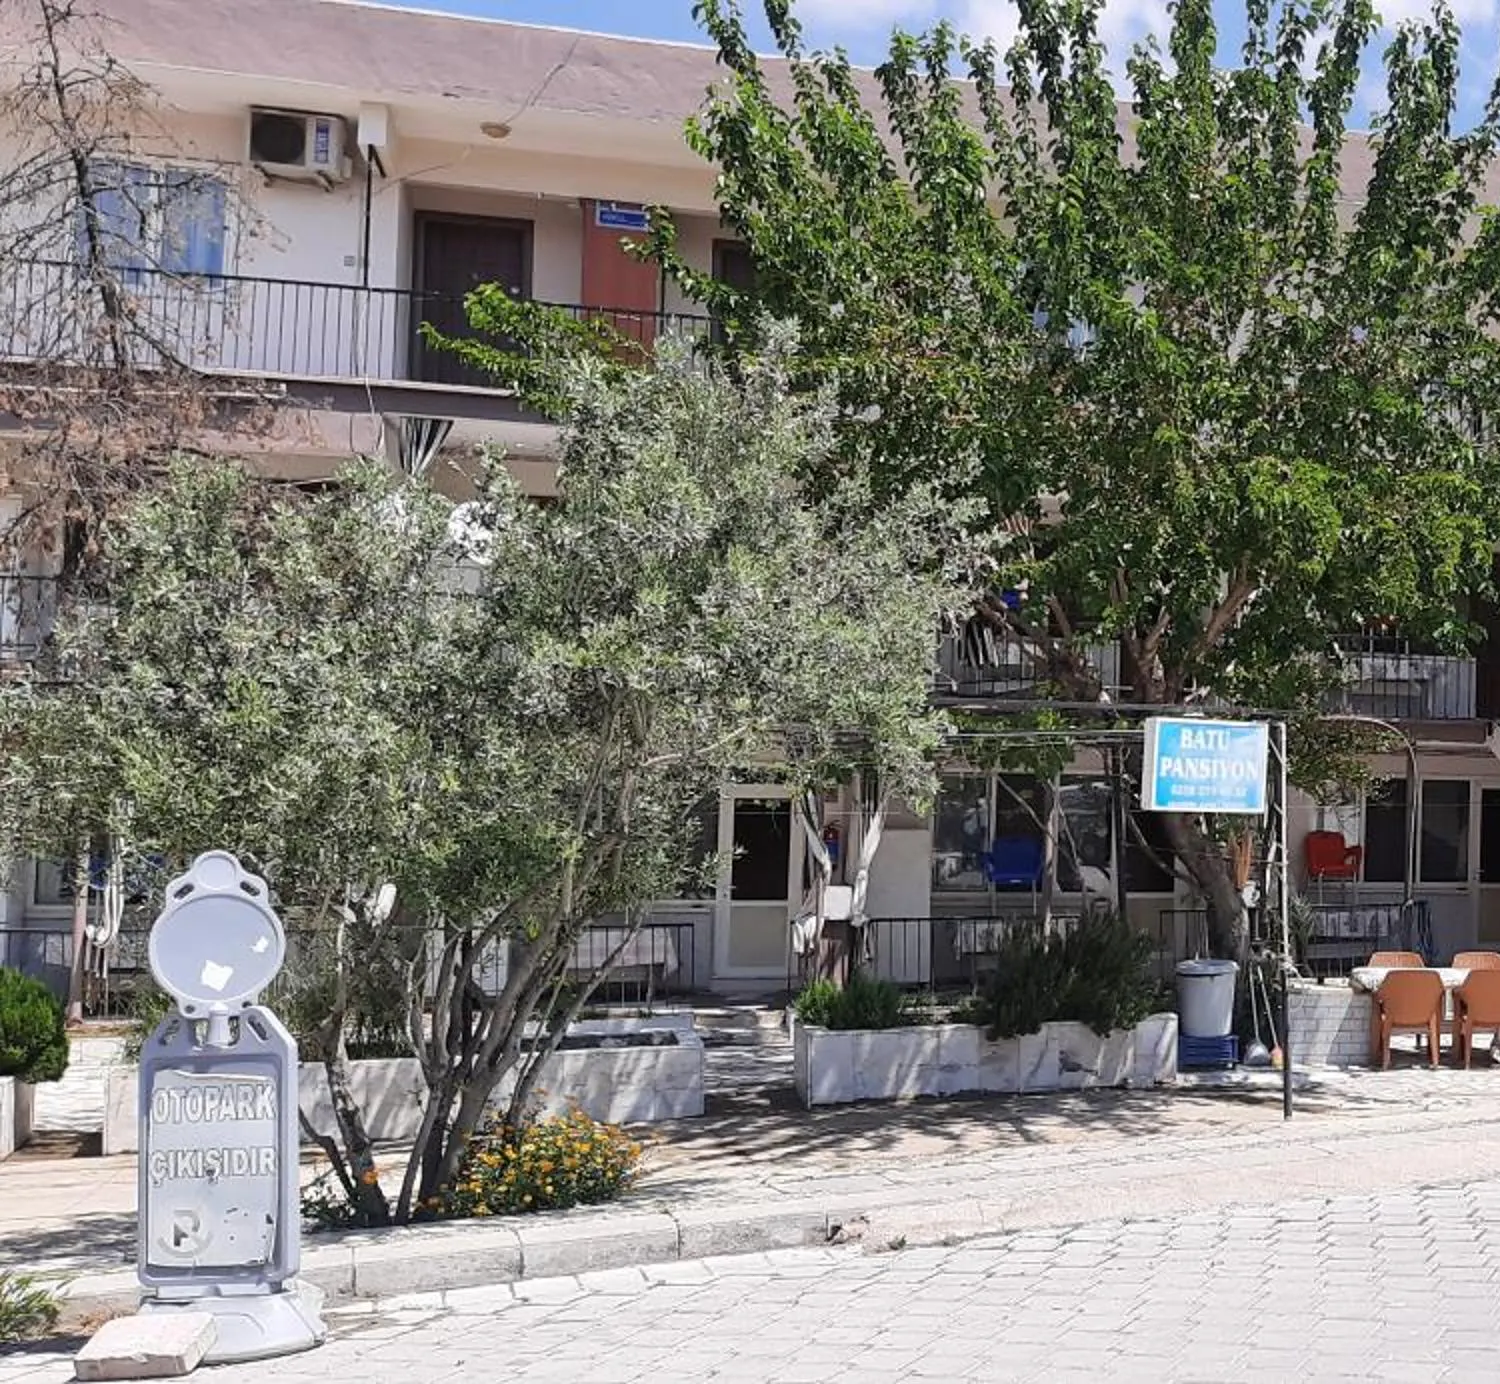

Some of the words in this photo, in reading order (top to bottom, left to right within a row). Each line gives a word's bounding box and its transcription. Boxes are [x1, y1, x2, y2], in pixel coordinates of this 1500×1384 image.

[1180, 727, 1231, 751] BATU
[152, 1084, 277, 1124] OTOPARK
[150, 1147, 277, 1187] ÇIKIŞIDIR
